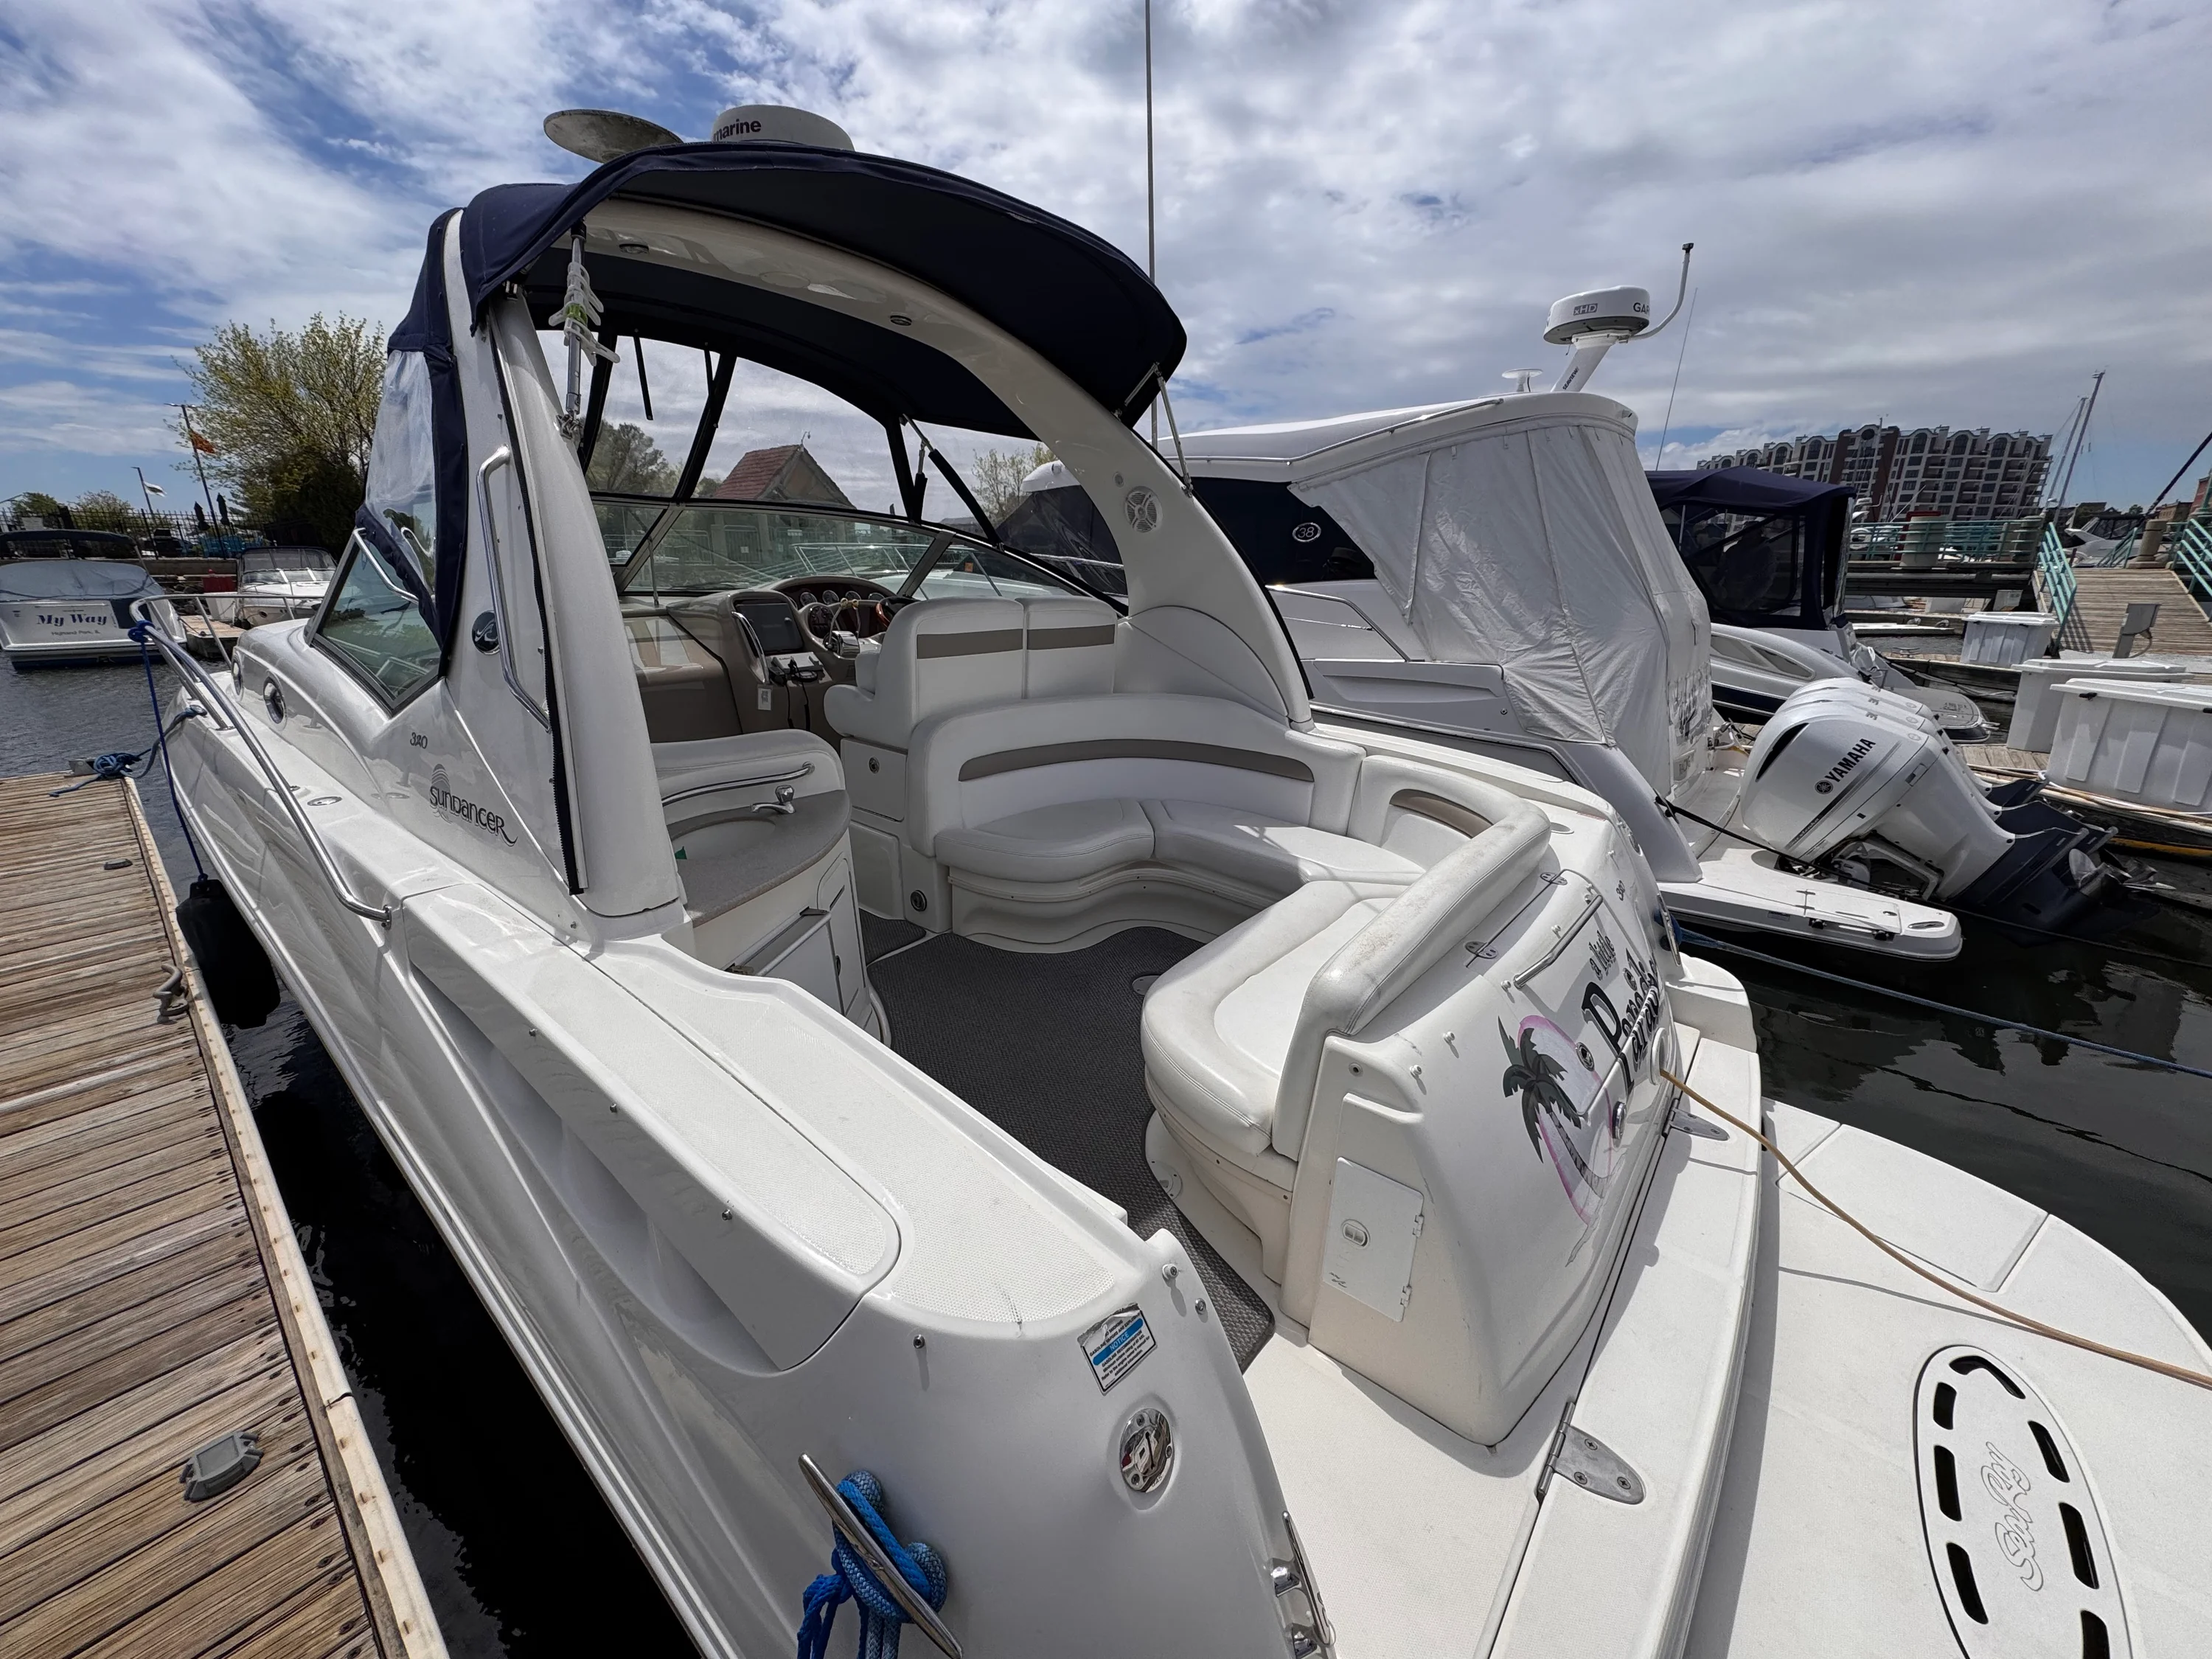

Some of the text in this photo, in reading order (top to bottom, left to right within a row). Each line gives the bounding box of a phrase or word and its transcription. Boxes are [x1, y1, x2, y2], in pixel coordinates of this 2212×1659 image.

[1298, 526, 1314, 538] 38
[36, 613, 107, 627] My Way
[1825, 738, 1876, 783] YAMAHA
[1588, 930, 1615, 981] a little
[1582, 947, 1659, 1095] Paradi
[1108, 1330, 1130, 1352] NOTICE
